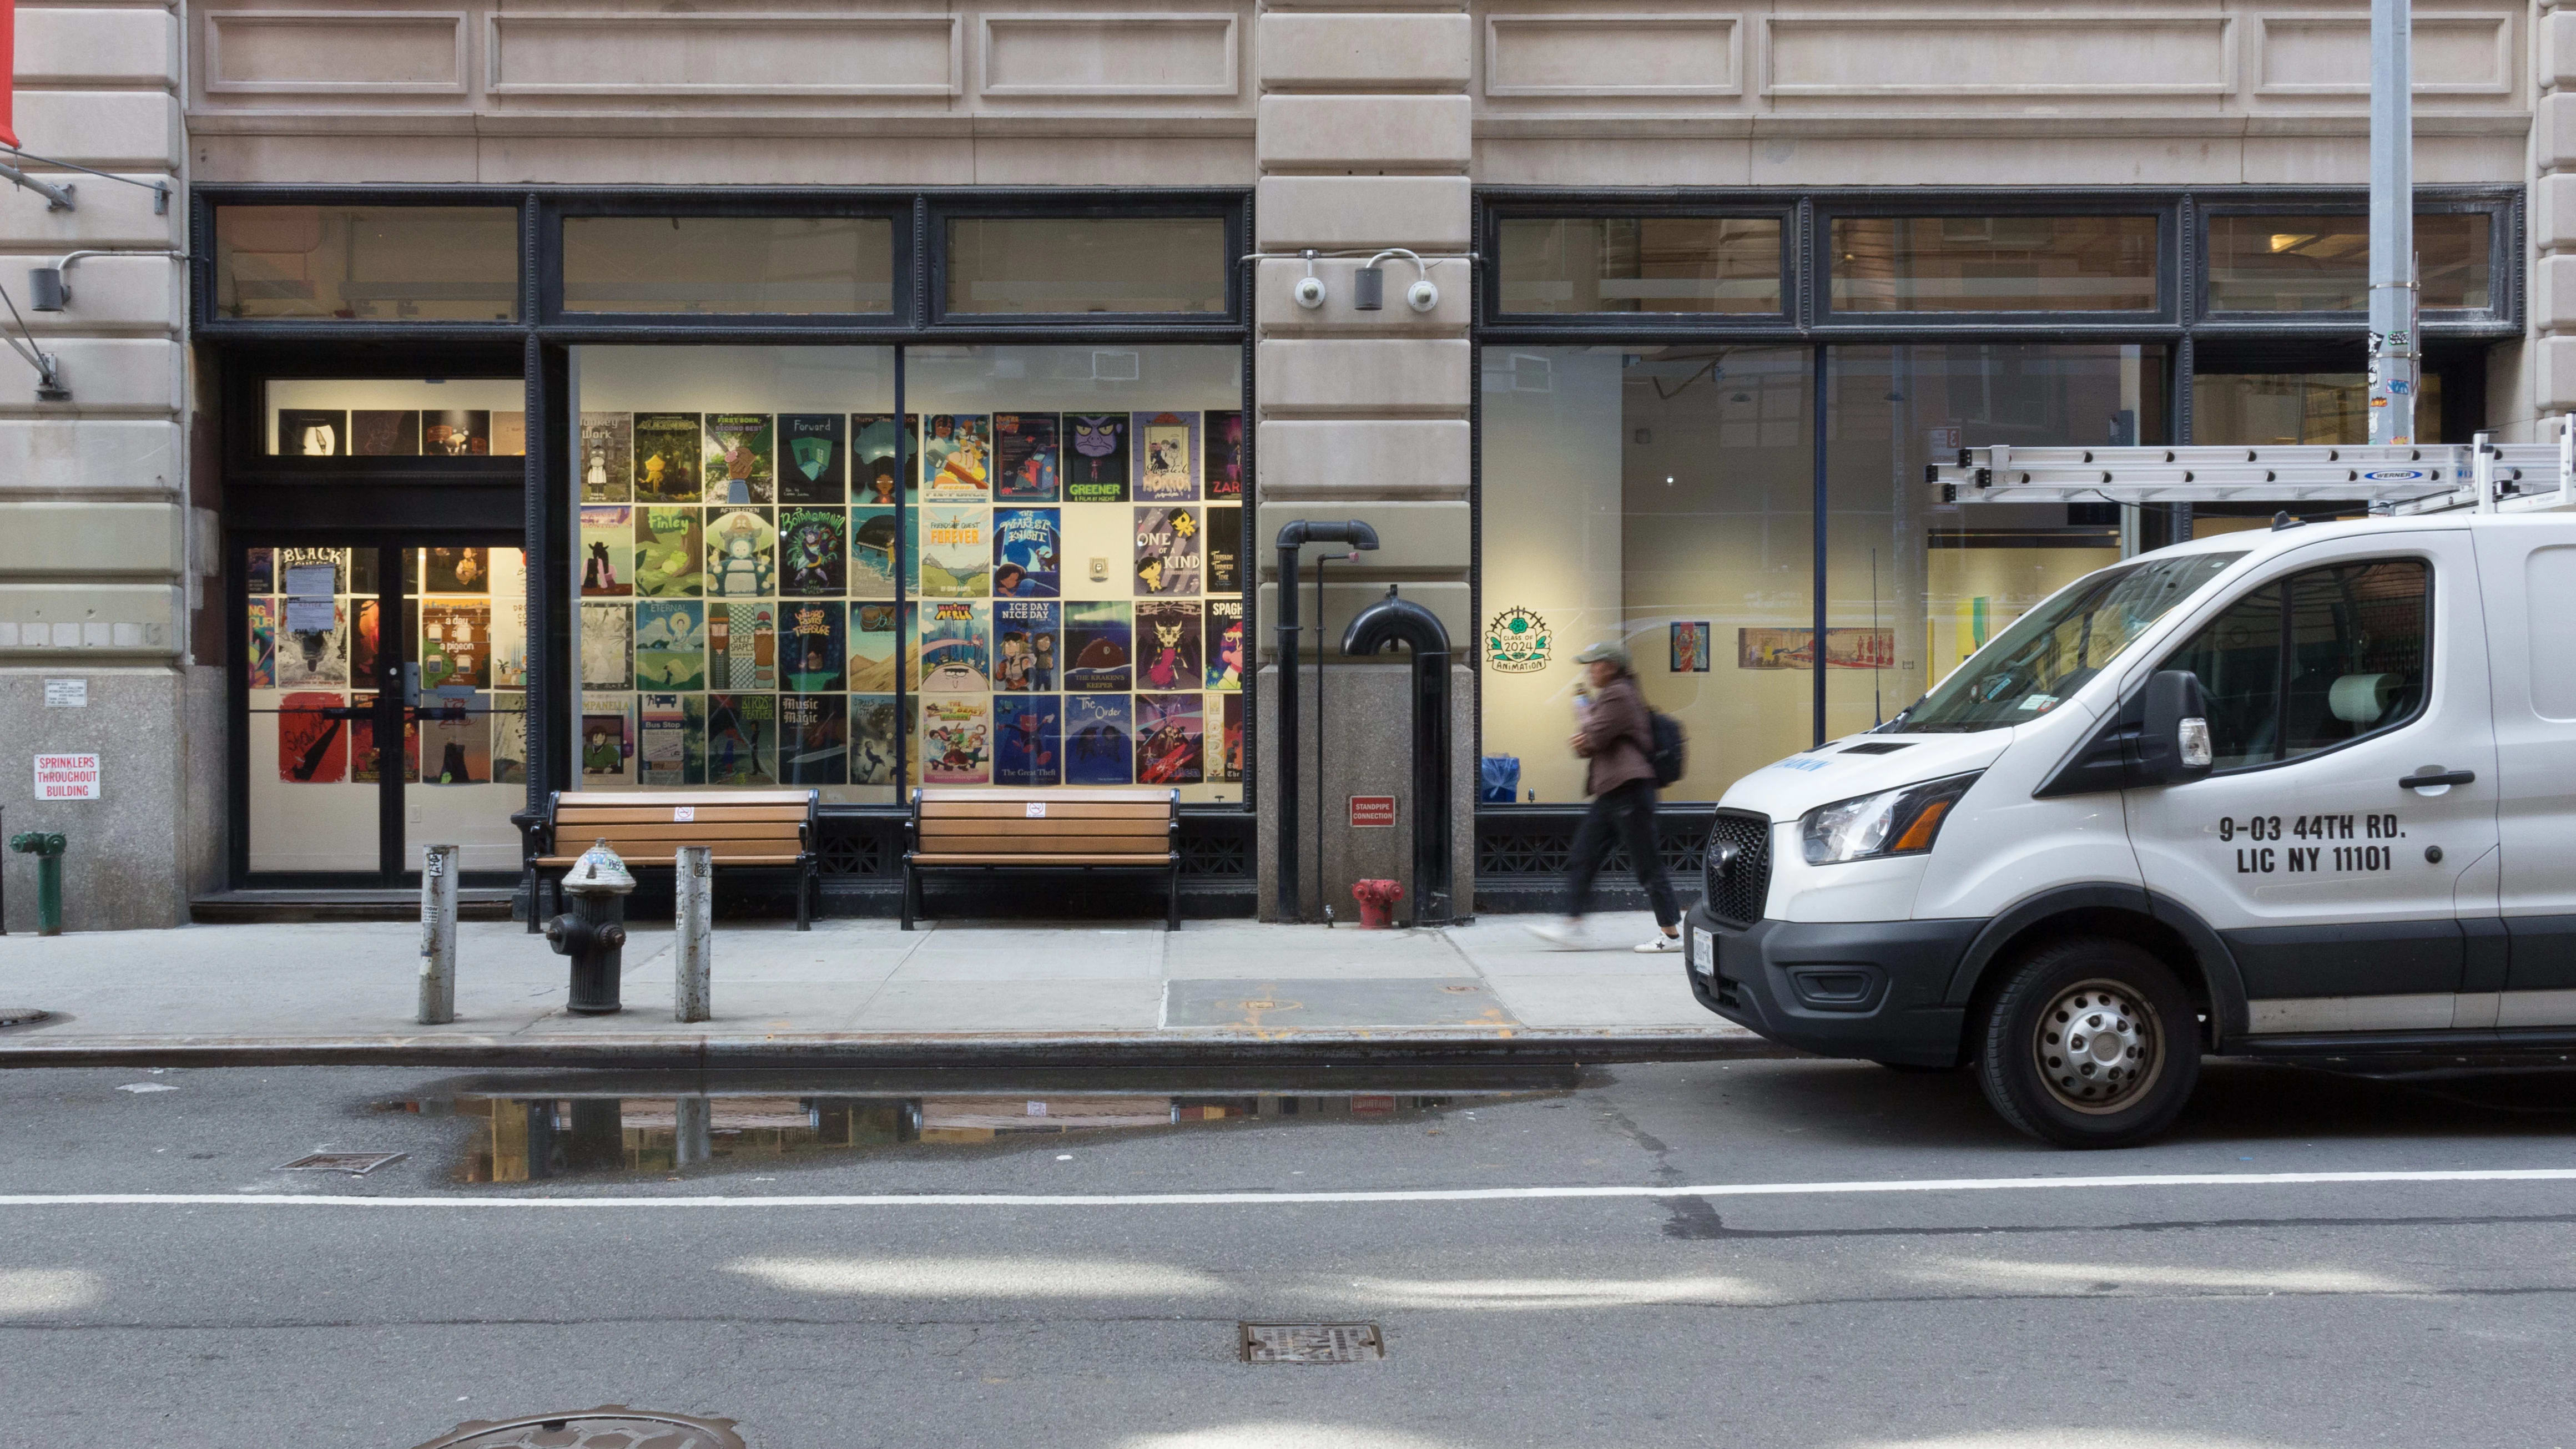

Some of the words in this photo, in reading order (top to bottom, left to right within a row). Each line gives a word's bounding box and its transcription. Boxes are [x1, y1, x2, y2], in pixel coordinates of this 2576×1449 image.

[794, 418, 830, 431] Forward
[583, 431, 612, 439] Work
[1070, 484, 1120, 495] GREENER
[1213, 481, 1242, 492] ZAR
[648, 516, 688, 535] Finley
[931, 529, 979, 544] FOREVER
[1009, 531, 1047, 542] KNIGHT
[1137, 533, 1171, 546] ONE
[284, 548, 341, 565] BLACK
[1163, 556, 1200, 569] KIND
[453, 615, 468, 625] day
[793, 625, 830, 637] TREASURE
[732, 635, 751, 644] SHEEP
[447, 642, 474, 653] pigeon
[730, 643, 754, 652] SHAPES
[1505, 642, 1534, 652] 2024
[742, 696, 769, 709] BIRDS
[783, 698, 818, 710] Music
[1077, 697, 1095, 710] The
[742, 709, 774, 719] FEATHER
[784, 711, 818, 725] Magic
[1095, 706, 1121, 719] Order
[39, 757, 94, 769] SPRINKLERS
[37, 771, 97, 782] THROUGHOUT
[47, 785, 88, 796] BUILDING
[2220, 816, 2281, 841] 9-03
[2293, 815, 2354, 840] 44TH
[2367, 814, 2406, 839] RD.
[2237, 848, 2275, 874] LIC
[2288, 847, 2320, 872] NY
[2333, 846, 2391, 871] 11101
